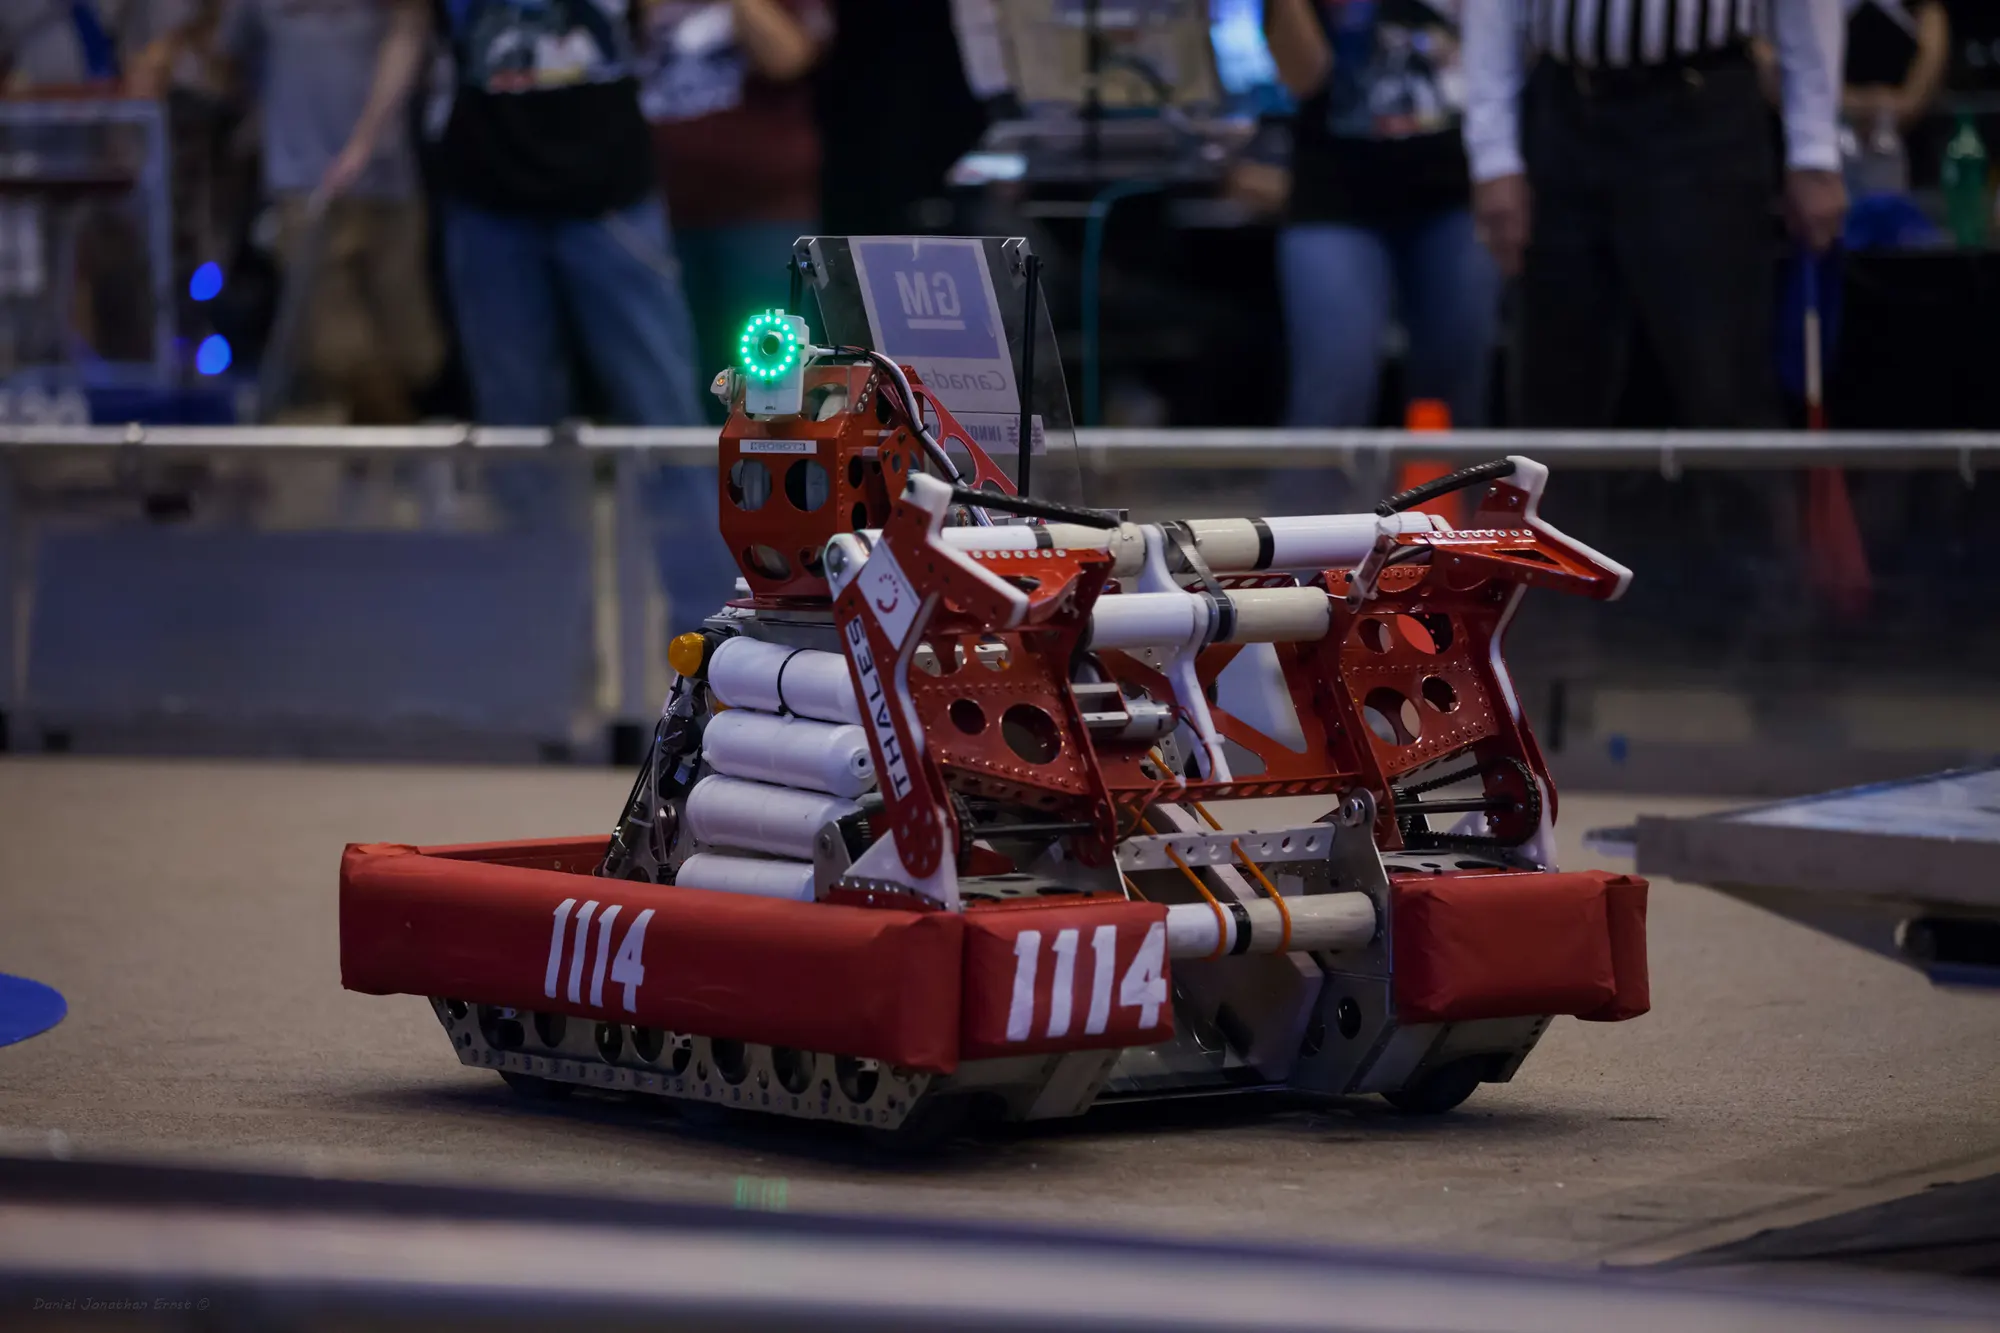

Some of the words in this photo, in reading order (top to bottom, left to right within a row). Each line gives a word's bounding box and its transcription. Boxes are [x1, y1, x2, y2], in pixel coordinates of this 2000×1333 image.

[849, 617, 908, 797] THALES
[544, 898, 656, 1013] 1114
[1006, 921, 1167, 1042] 1114
